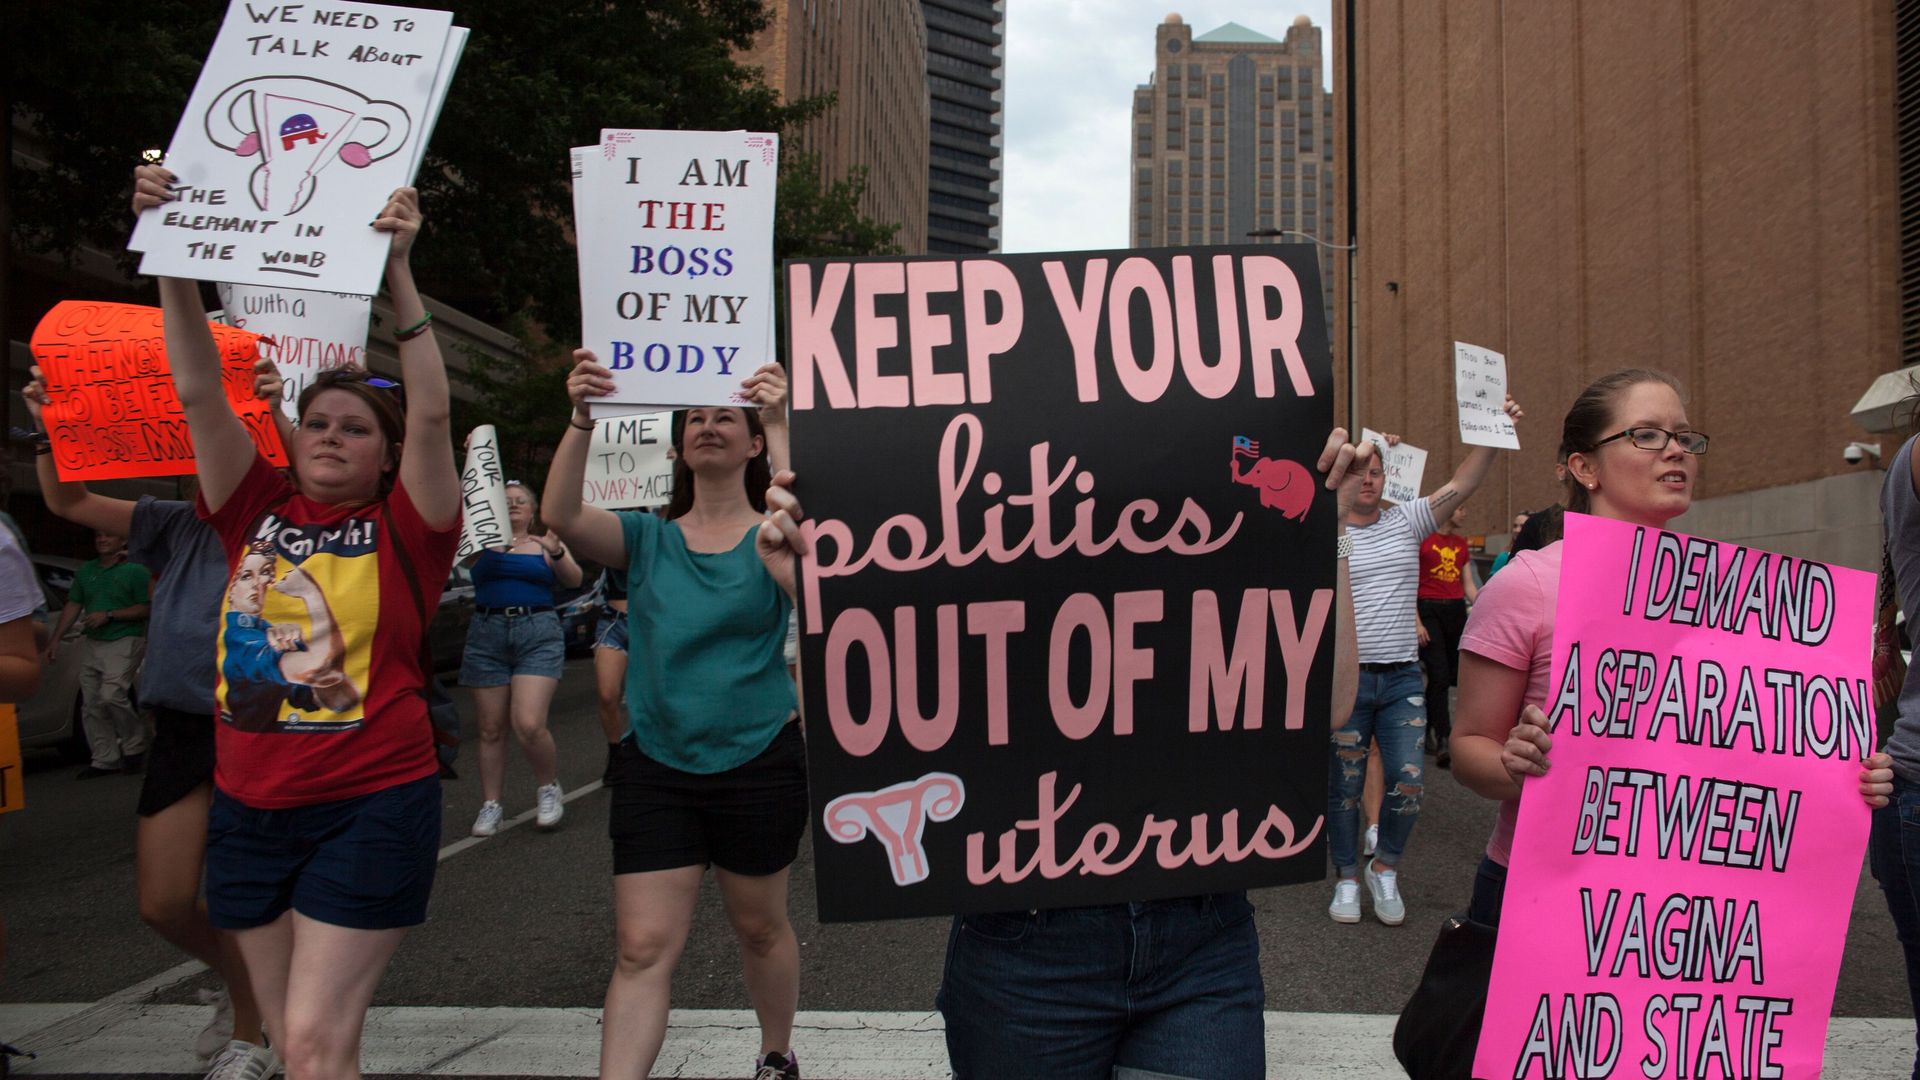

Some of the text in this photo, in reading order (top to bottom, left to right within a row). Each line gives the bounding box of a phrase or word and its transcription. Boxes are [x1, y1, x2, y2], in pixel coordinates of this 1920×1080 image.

[246, 3, 303, 24] WE
[313, 10, 379, 30] NEED
[247, 35, 330, 58] TALK
[625, 157, 750, 187] I AM
[172, 185, 227, 205] THE
[638, 200, 725, 231] THE
[163, 211, 323, 237] ELEPHANT IN
[187, 242, 236, 260] THE
[630, 245, 734, 278] BOSS
[617, 291, 749, 324] OF MY
[789, 254, 1315, 411] KEEP YOUR
[36, 337, 164, 388] THINGS
[609, 341, 740, 375] BODY
[46, 386, 93, 424] TO
[97, 378, 144, 424] BE
[141, 418, 195, 462] MY
[604, 418, 660, 446] IME
[473, 439, 501, 487] YOUR
[598, 450, 635, 476] TO
[463, 468, 507, 551] POLITICAL
[798, 413, 1244, 634] politics
[278, 527, 315, 556] Can
[1623, 526, 1836, 647] I DEMAND
[824, 588, 1334, 757] OUT OF MY
[1549, 641, 1872, 762] A SEPARATION
[965, 771, 1324, 885] uterus
[1572, 766, 1802, 873] BETWEEN
[1579, 886, 1764, 984] VAGINA
[1513, 992, 1794, 1080] AND STATE
